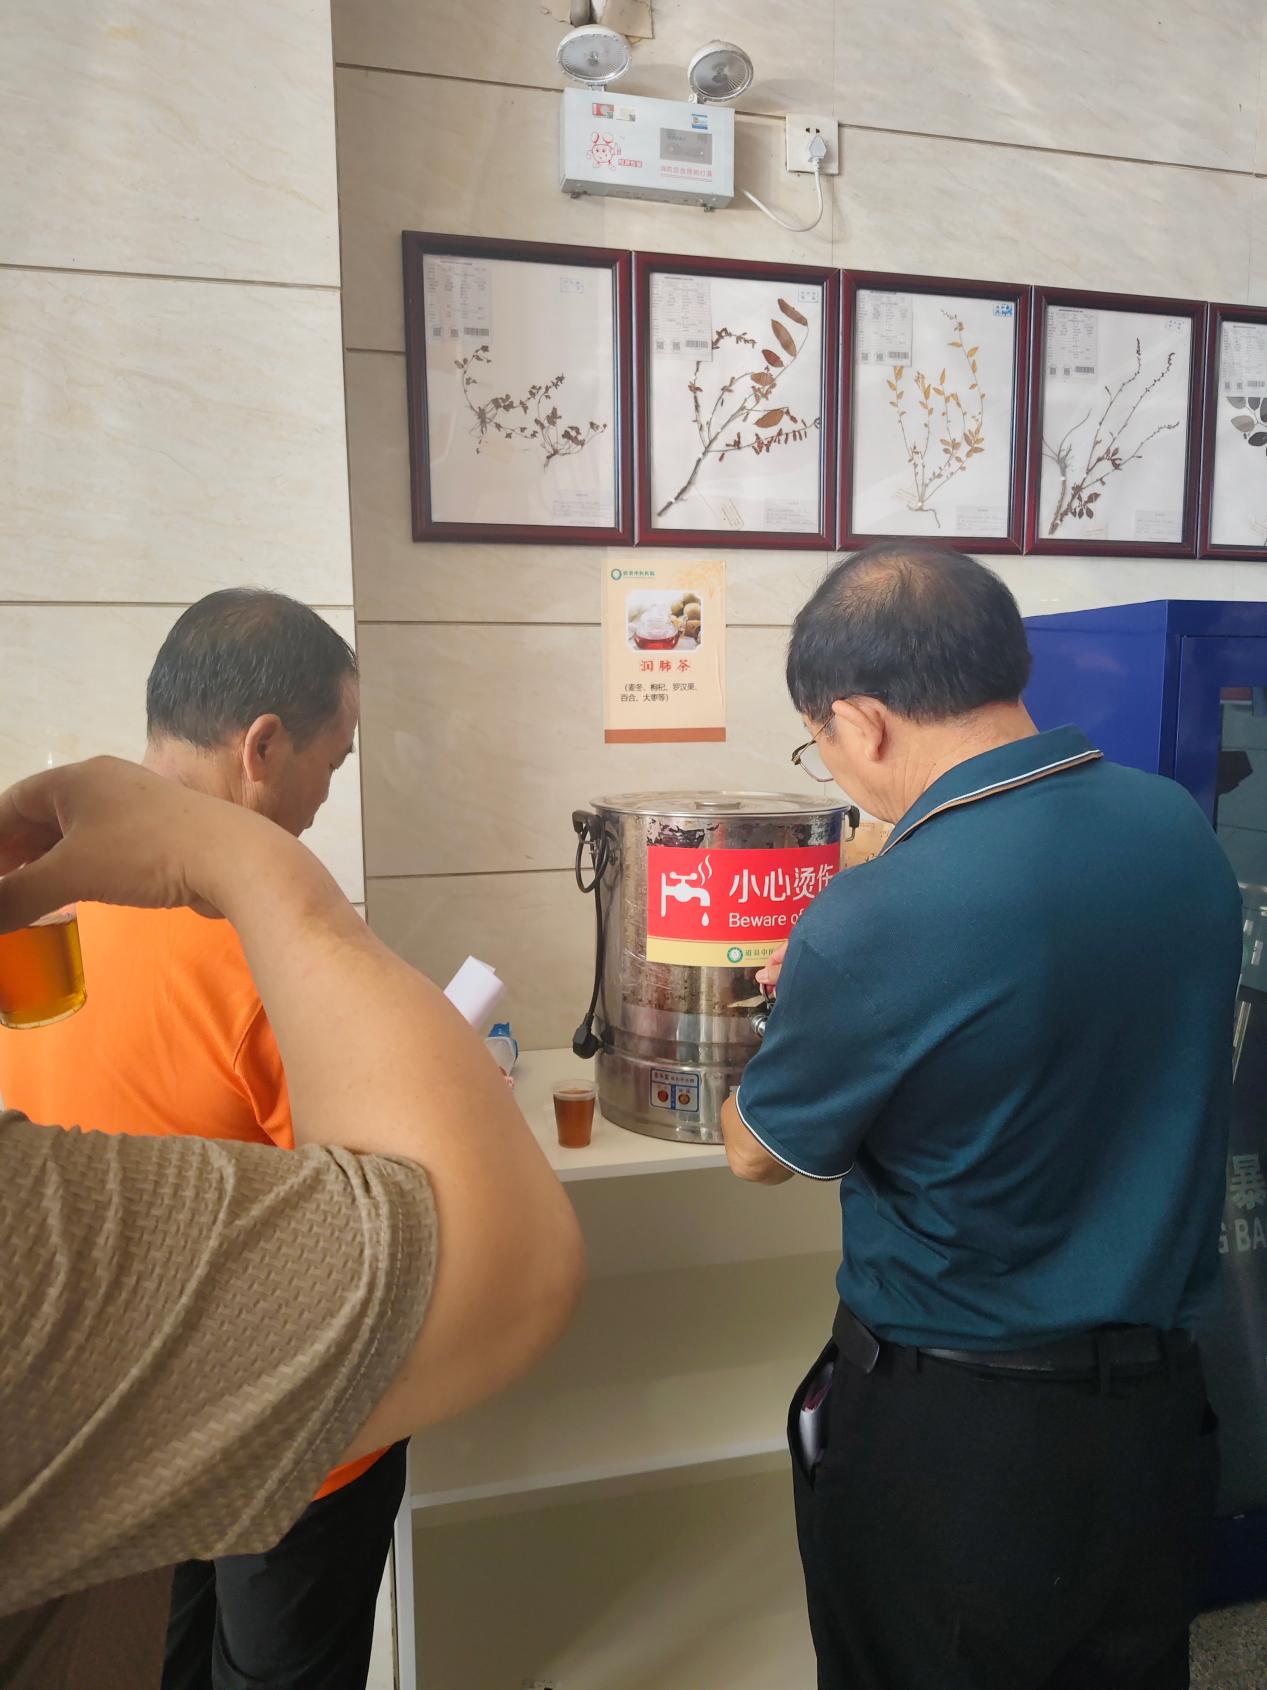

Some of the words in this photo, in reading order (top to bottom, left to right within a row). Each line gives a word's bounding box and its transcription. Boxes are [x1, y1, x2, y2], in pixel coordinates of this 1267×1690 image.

[640, 659, 691, 673] 润肺茶
[729, 864, 834, 904] 小心烫伤
[729, 912, 787, 928] Beware
